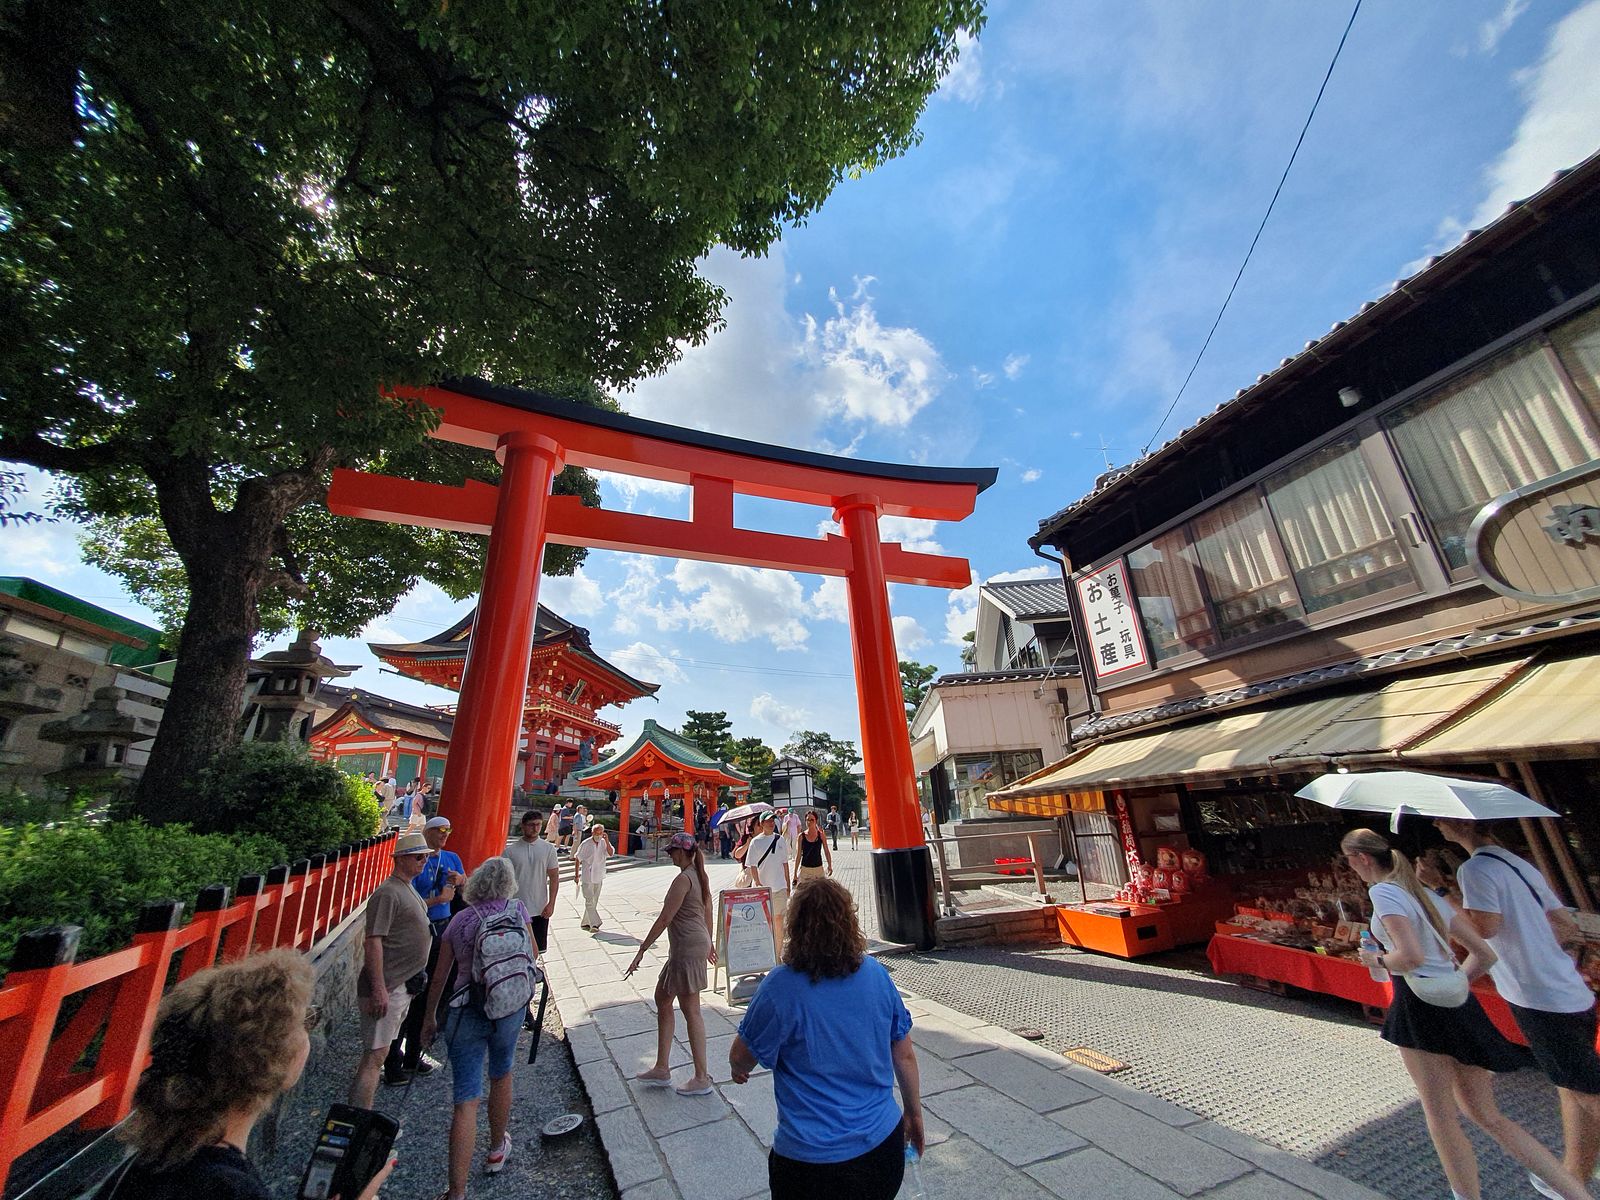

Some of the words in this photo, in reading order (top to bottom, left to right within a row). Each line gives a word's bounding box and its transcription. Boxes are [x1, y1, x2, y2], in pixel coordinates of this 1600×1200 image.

[1087, 582, 1119, 667] お土産
[1106, 573, 1136, 660] お菓子・玩具
